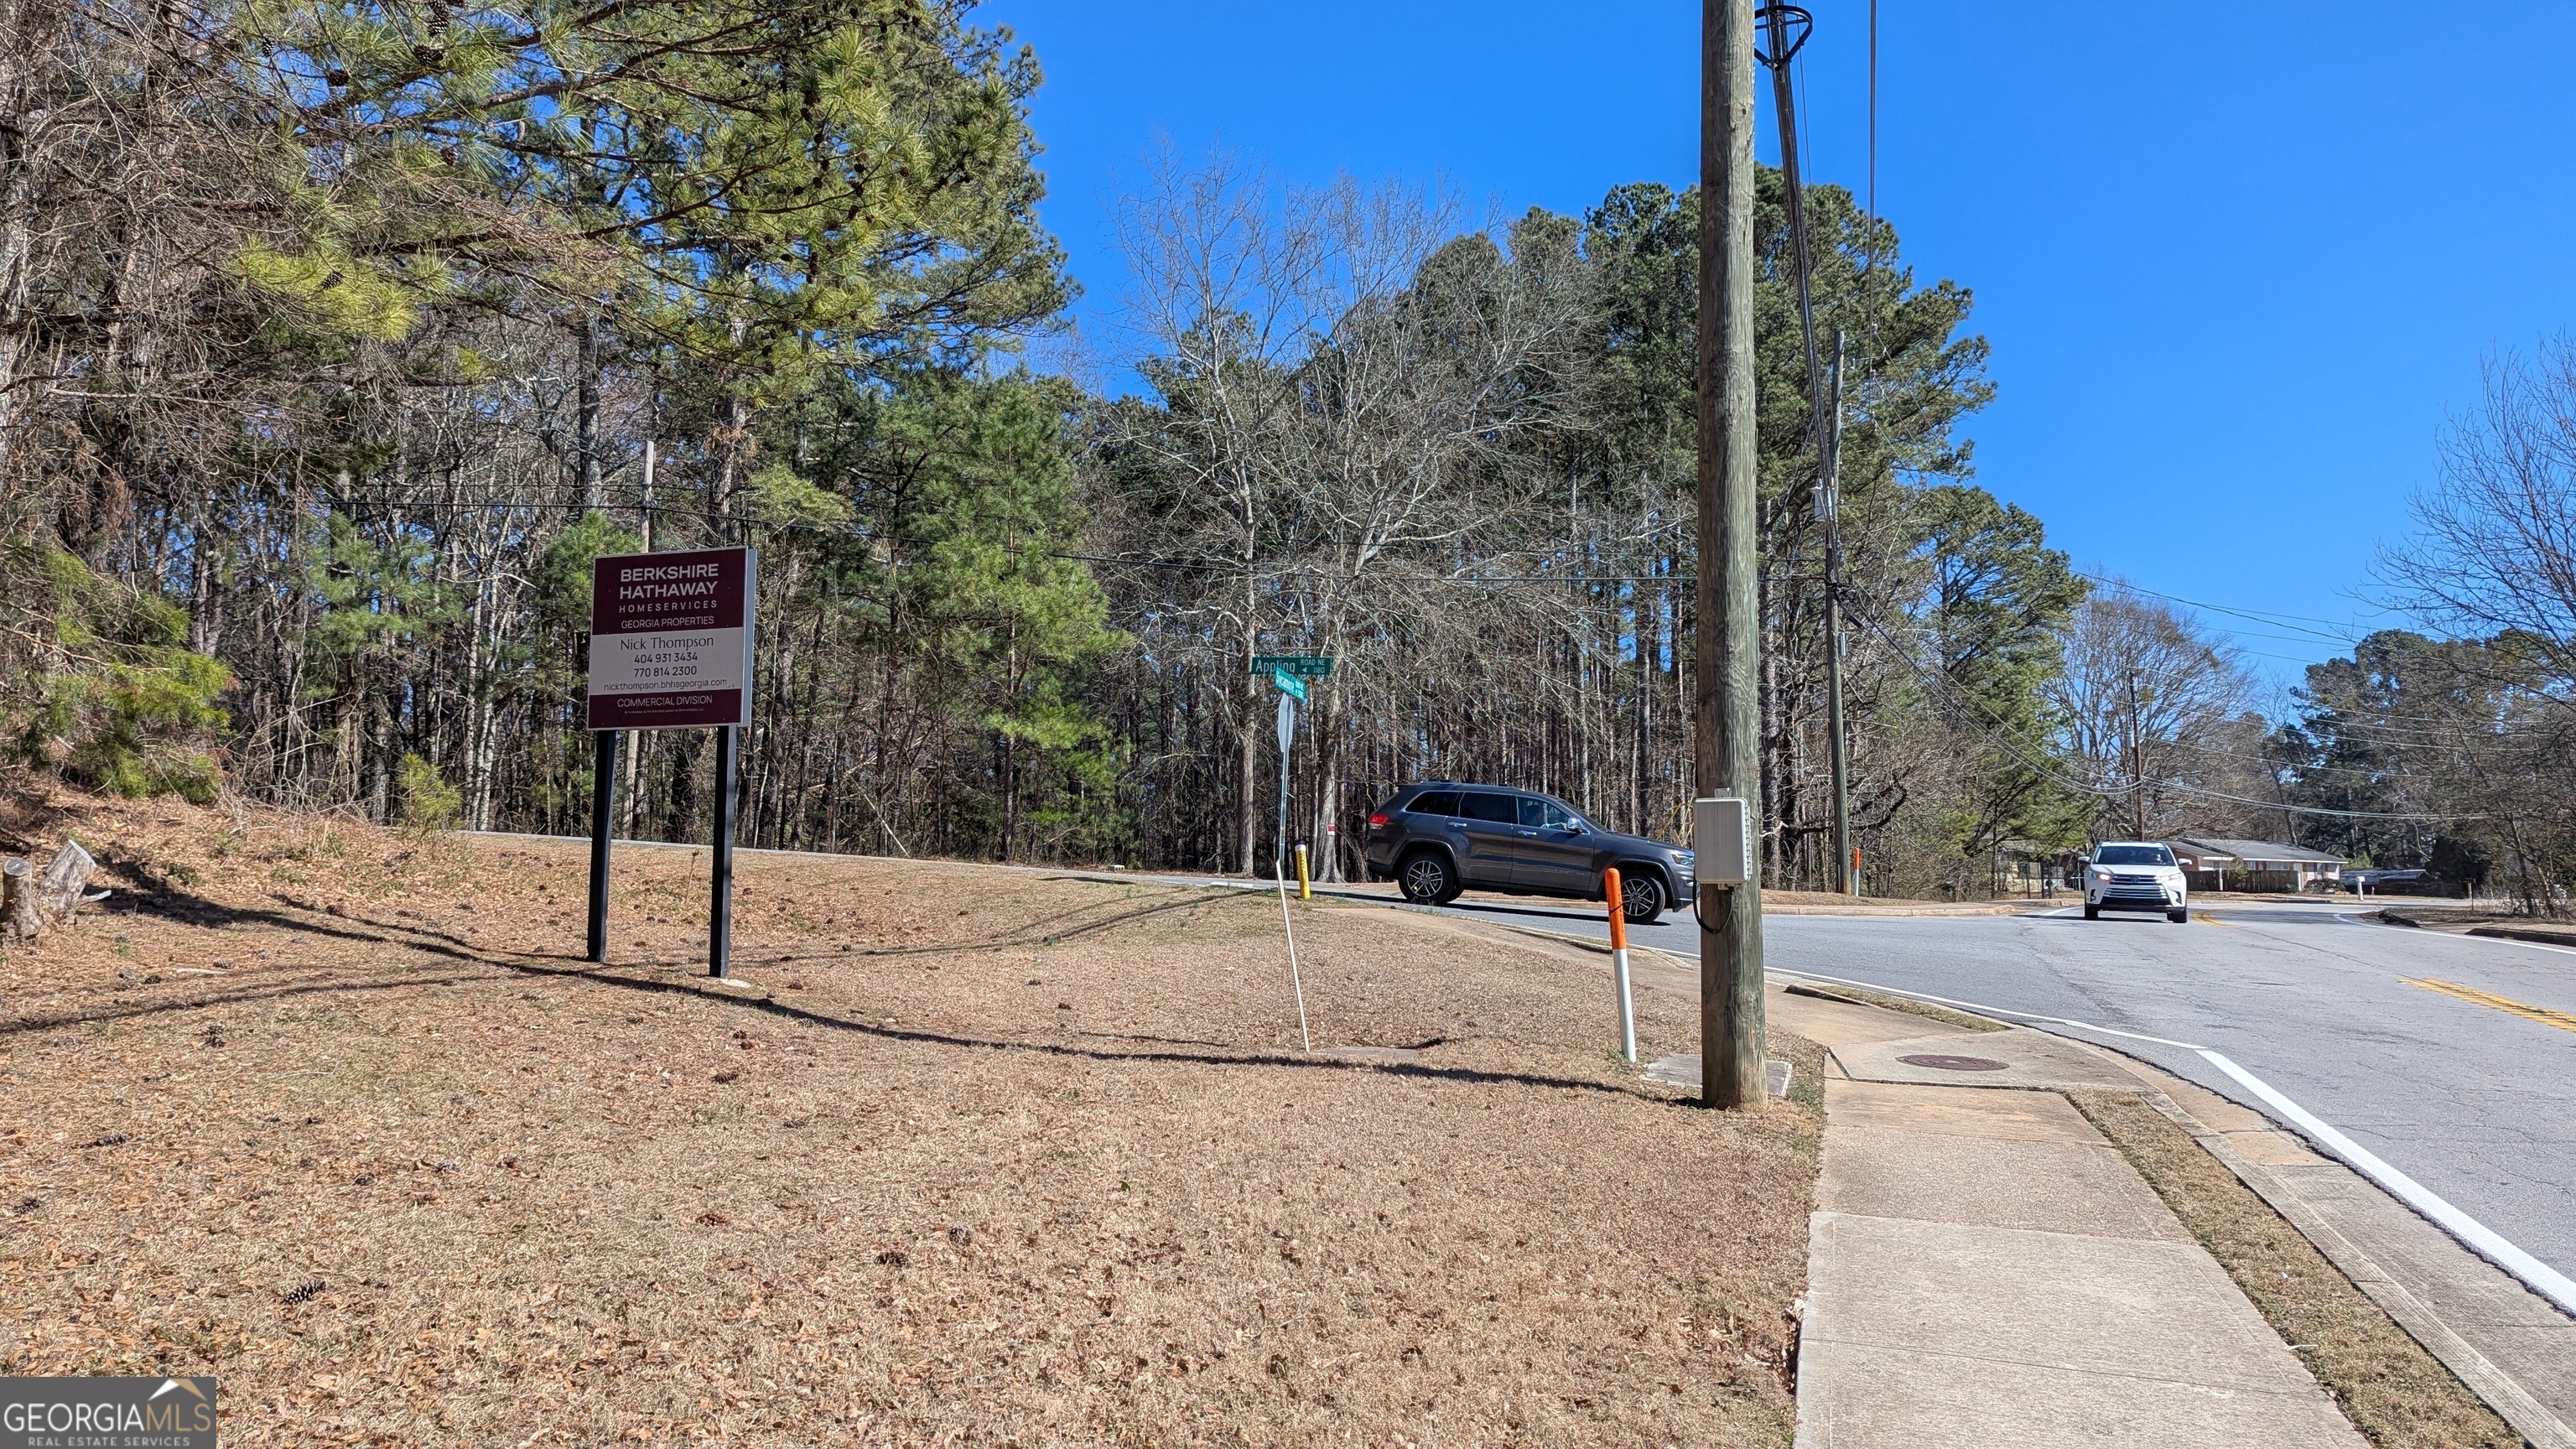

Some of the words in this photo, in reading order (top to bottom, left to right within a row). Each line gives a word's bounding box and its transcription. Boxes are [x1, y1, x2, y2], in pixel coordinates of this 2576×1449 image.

[620, 564, 719, 581] BERKSHIRE
[619, 581, 718, 600] HATHAWAY
[619, 600, 718, 614] HOMESERVICES
[621, 619, 660, 629] GEORGIA
[661, 615, 714, 628] PROPERTIES
[620, 637, 647, 651] Nick
[650, 636, 714, 652] Thompson
[634, 654, 653, 664] 404
[655, 653, 672, 663] 931
[673, 652, 699, 662] 3434
[633, 667, 652, 678] 770
[653, 667, 670, 677] 814
[672, 665, 698, 677] 2300
[604, 678, 728, 693] nickthompson.bhhsgeorgia.com
[617, 696, 676, 708] COMMERCIAL
[676, 695, 713, 706] DIVISION
